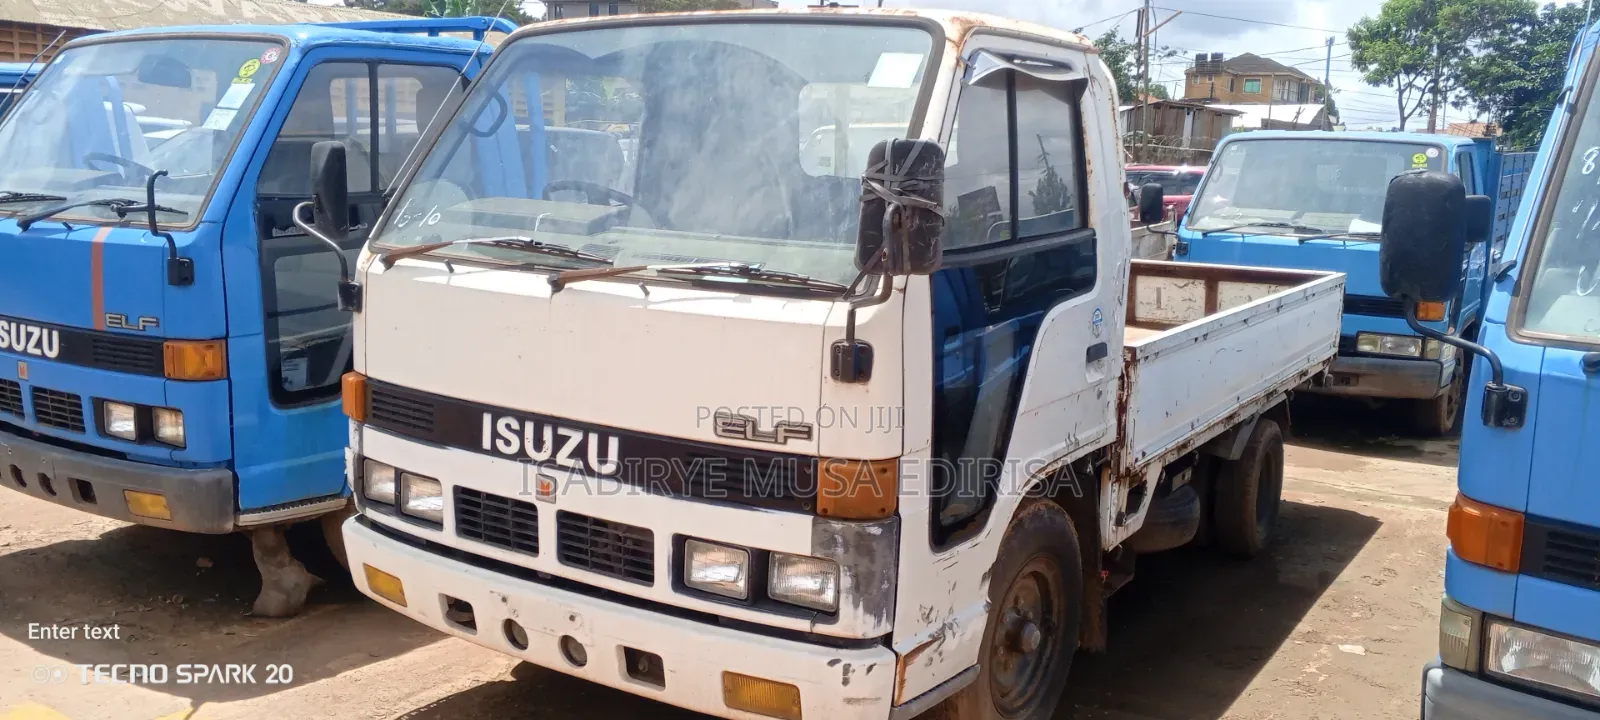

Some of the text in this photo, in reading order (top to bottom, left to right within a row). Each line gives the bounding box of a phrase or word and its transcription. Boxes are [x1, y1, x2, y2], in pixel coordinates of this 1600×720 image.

[0, 319, 60, 359] SUZU
[105, 312, 160, 331] ELF
[482, 412, 620, 475] ISUZU
[713, 411, 814, 445] ELF
